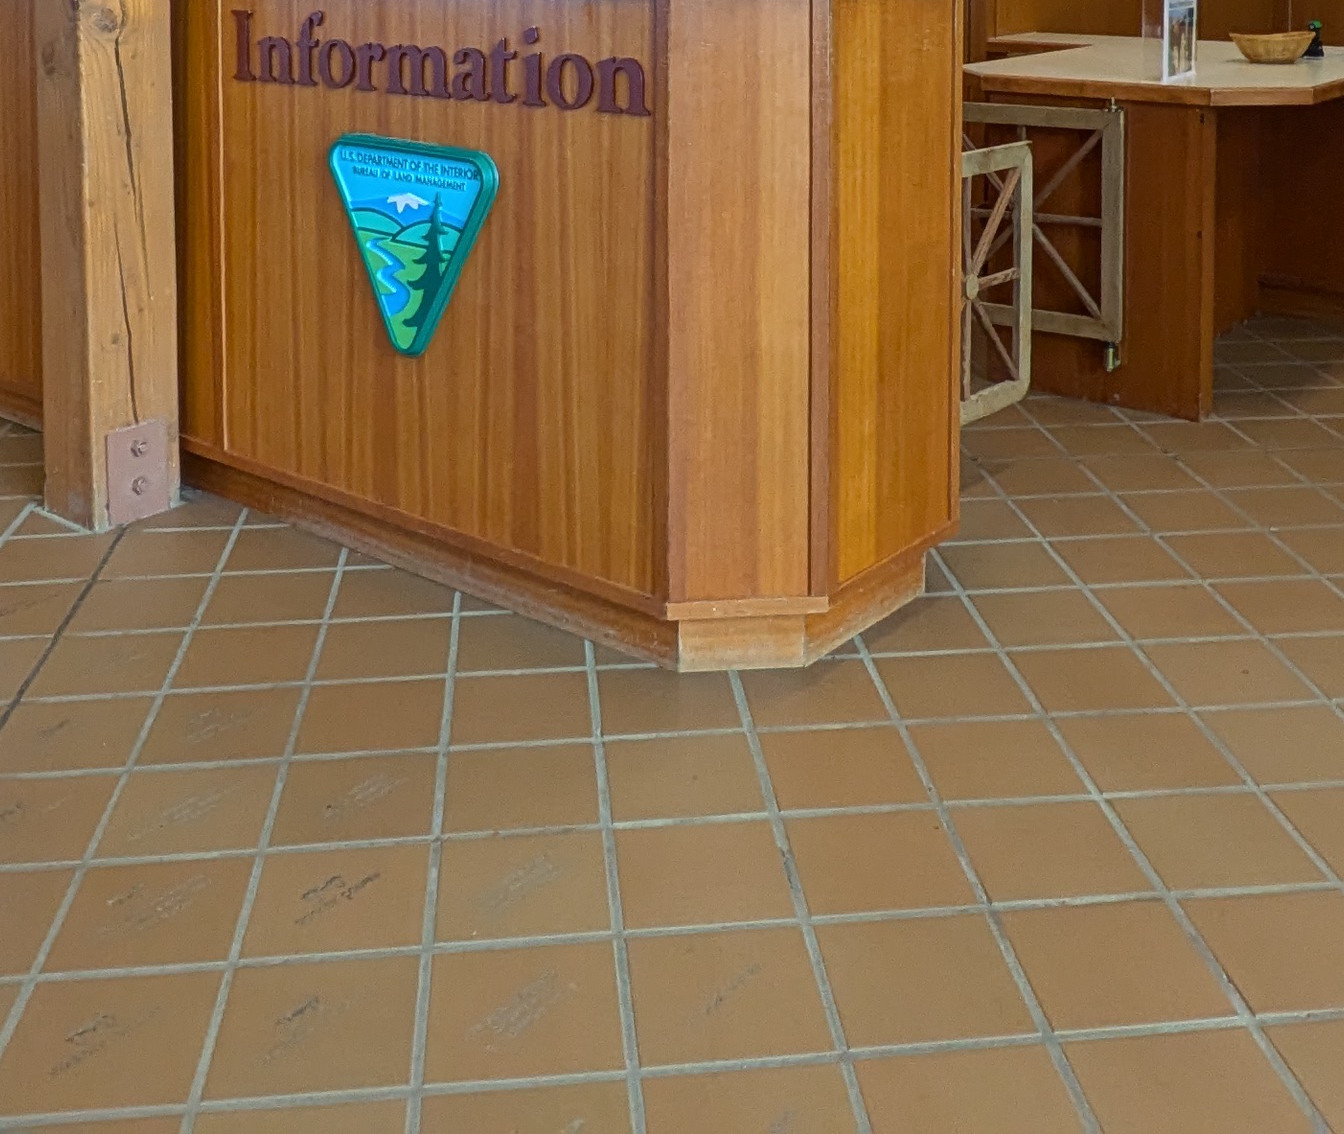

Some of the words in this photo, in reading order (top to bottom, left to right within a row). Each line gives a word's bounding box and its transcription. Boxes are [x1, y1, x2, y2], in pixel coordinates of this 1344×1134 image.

[233, 9, 652, 117] Information
[340, 149, 357, 163] U.S.
[357, 153, 408, 170] DEPARTMENT
[410, 159, 422, 172] OF
[423, 162, 440, 175] THE
[441, 164, 480, 181] INTERIOR
[353, 165, 379, 178] BUREAU
[381, 169, 392, 180] OF
[394, 171, 413, 184] LAND
[415, 174, 467, 192] MANAGEMENT
